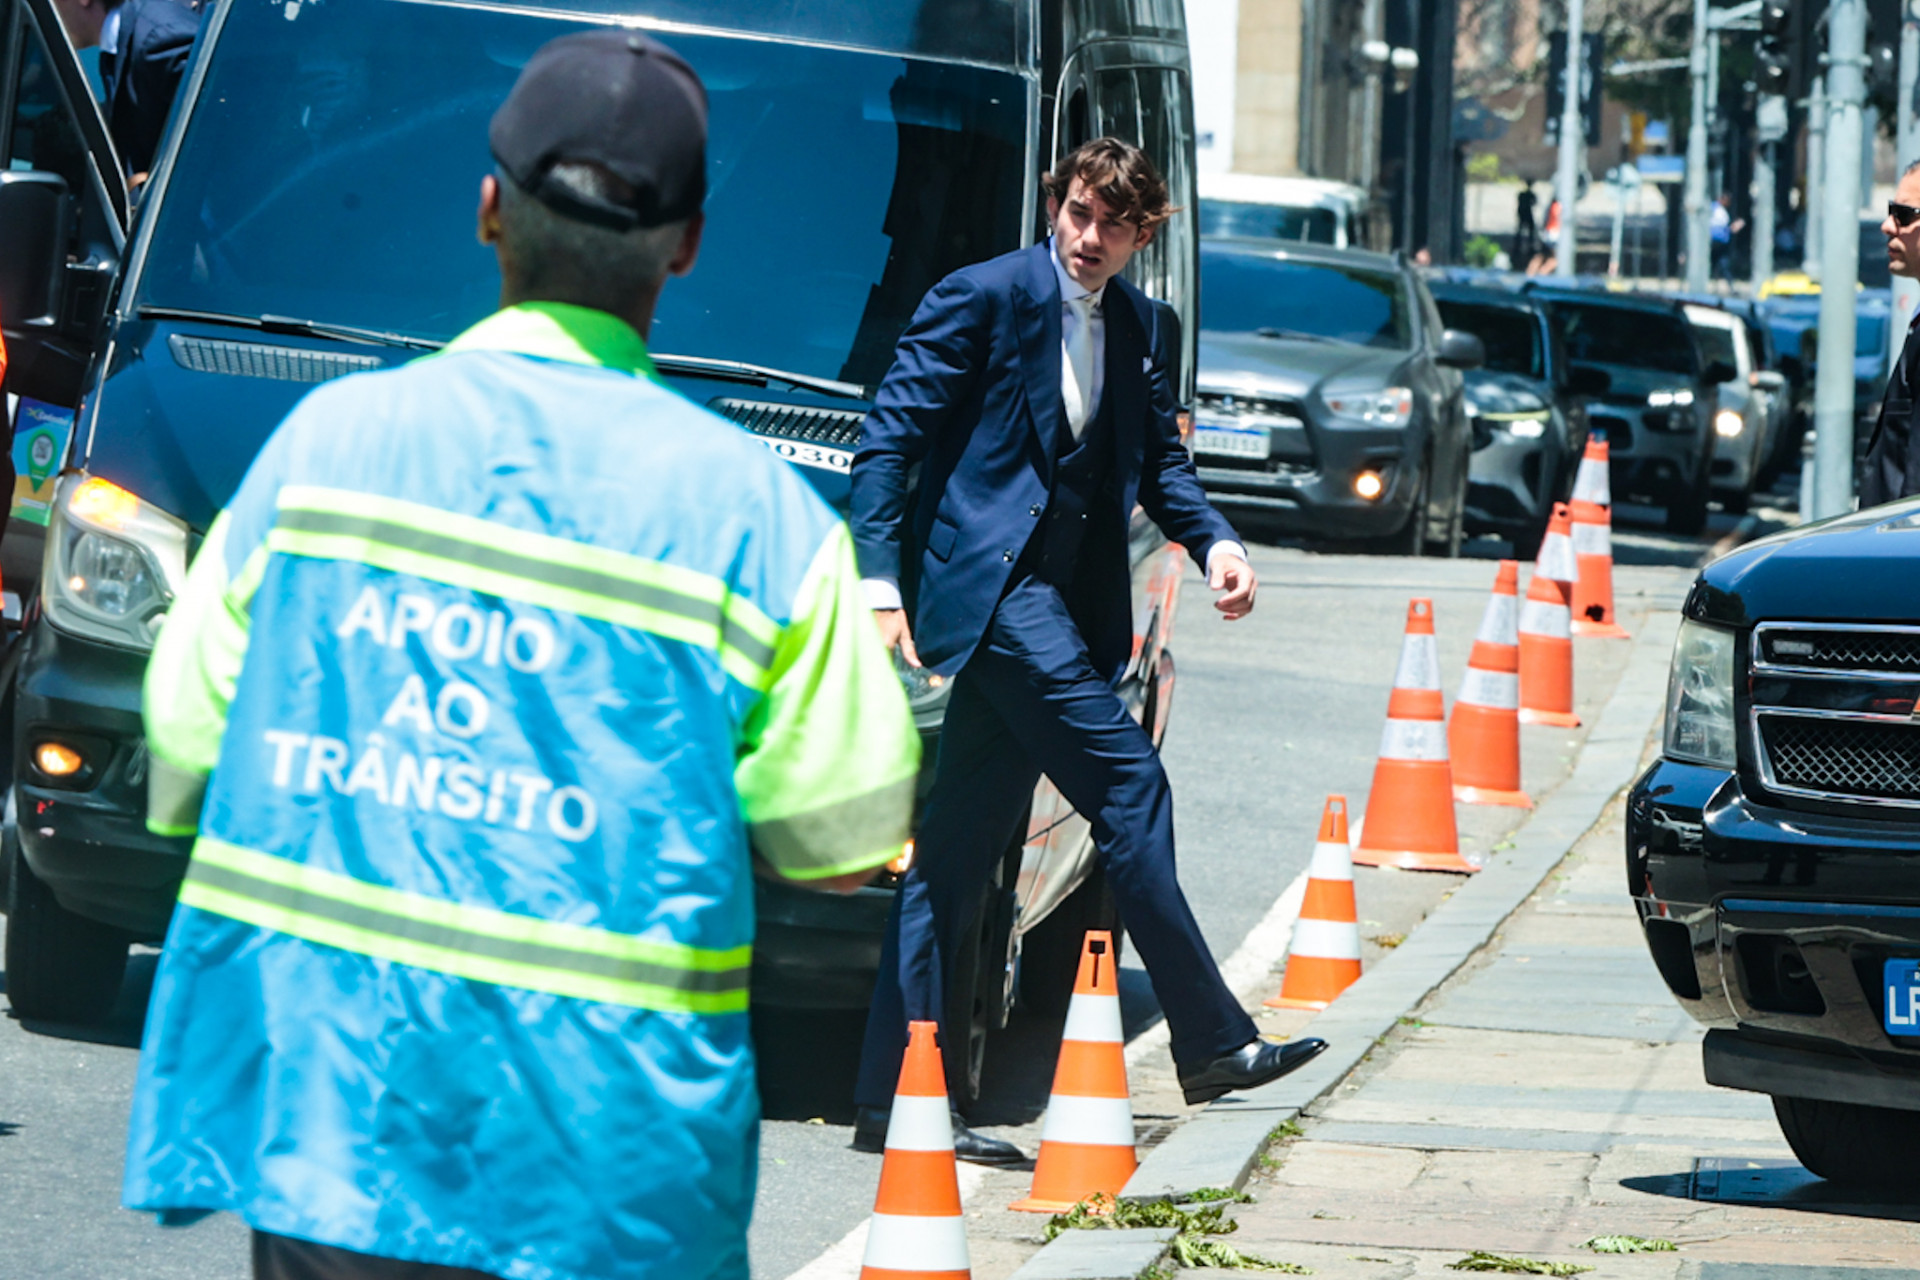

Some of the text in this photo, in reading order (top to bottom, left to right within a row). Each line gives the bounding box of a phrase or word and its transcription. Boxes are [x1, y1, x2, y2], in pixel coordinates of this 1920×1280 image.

[762, 440, 849, 468] 030
[337, 585, 556, 674] APOIO
[383, 674, 490, 739] AO
[264, 730, 598, 842] TRÂNSITO
